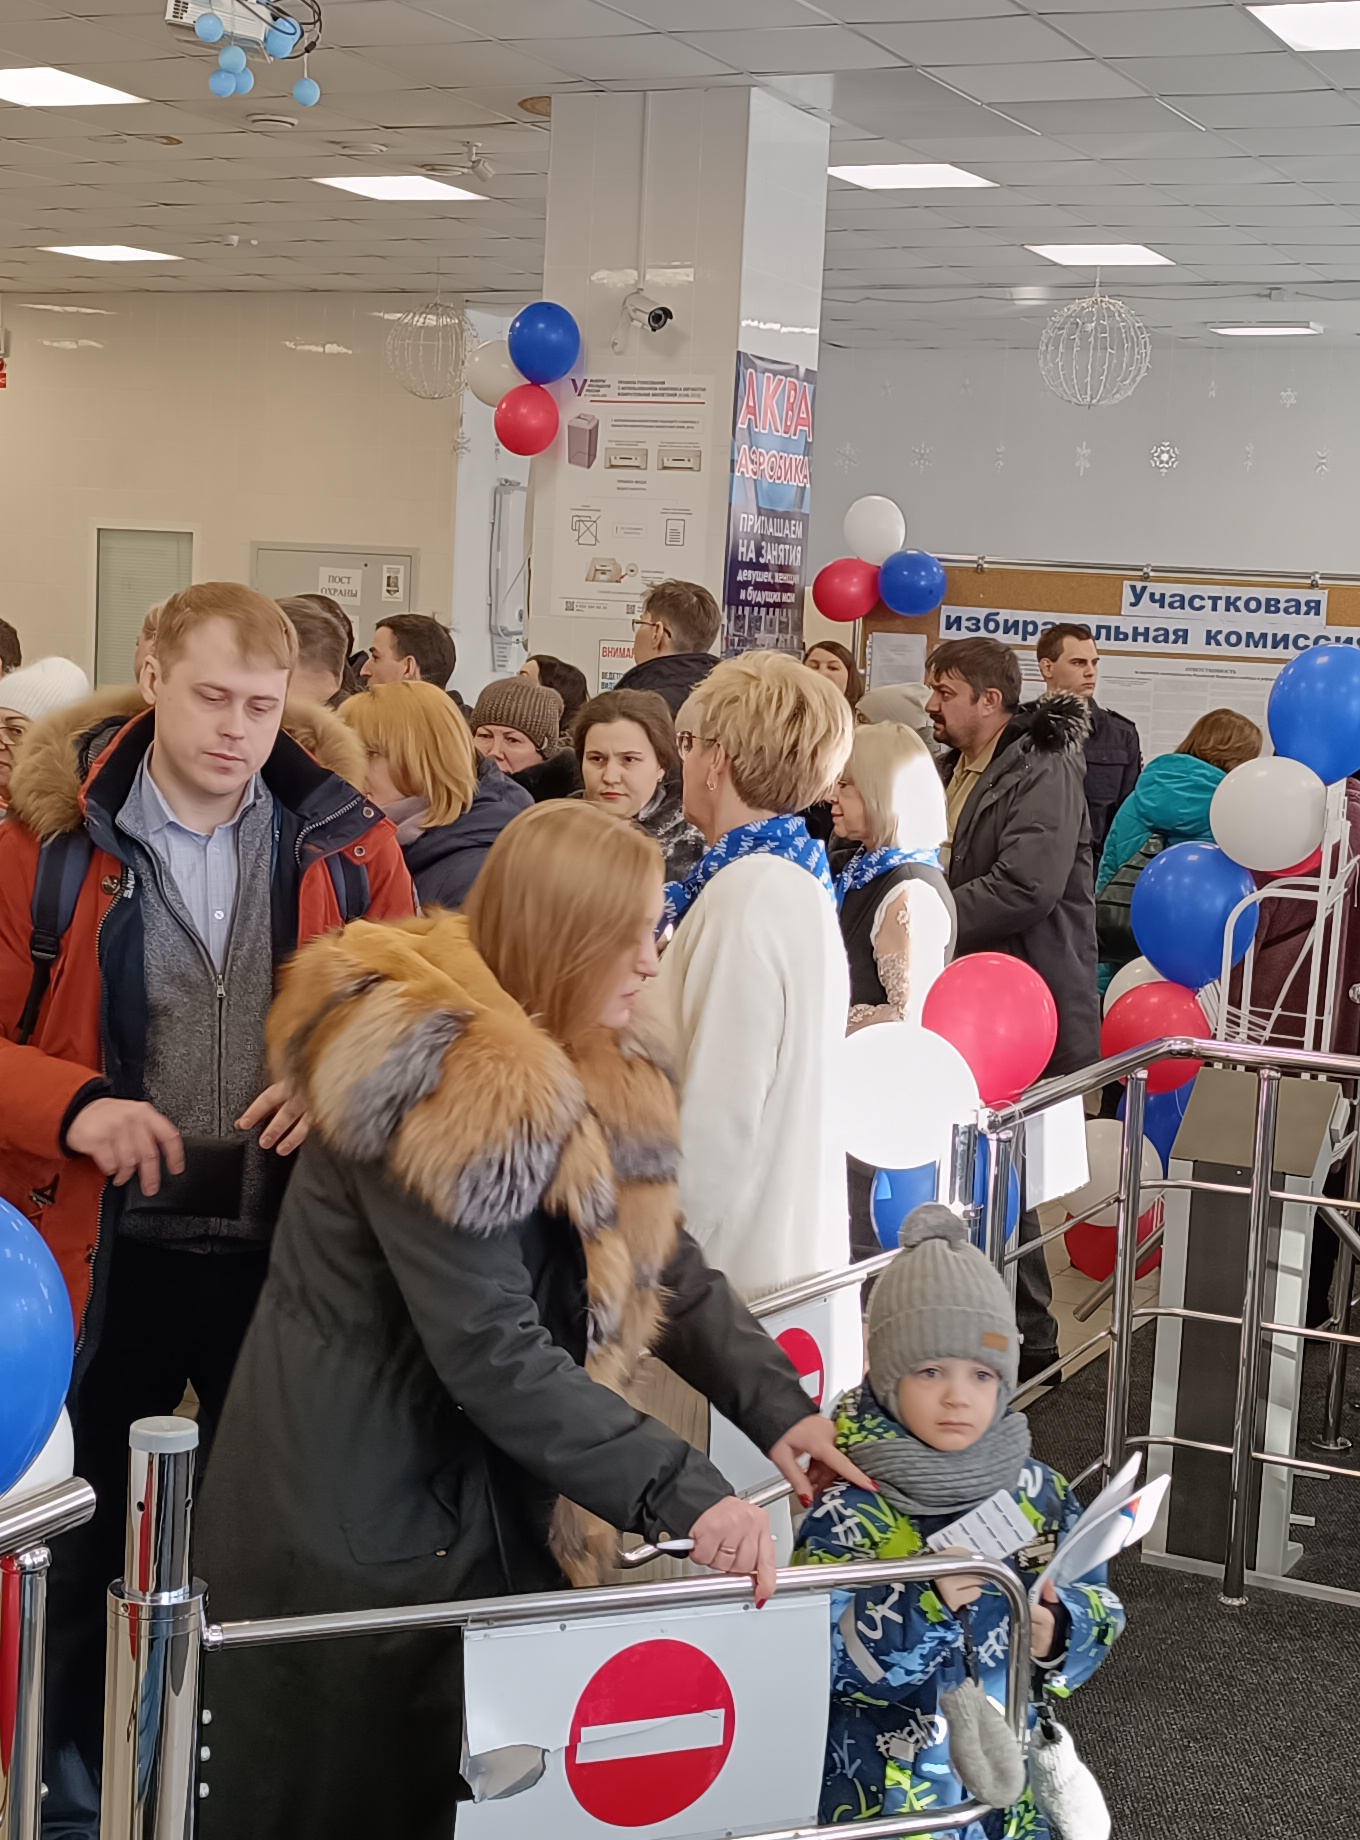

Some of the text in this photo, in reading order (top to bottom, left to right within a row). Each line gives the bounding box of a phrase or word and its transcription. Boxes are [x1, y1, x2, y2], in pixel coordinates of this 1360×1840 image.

[739, 368, 813, 442] АКВА
[735, 445, 811, 487] АЭРОБИКА
[740, 513, 802, 539] ПРИГЛАШАЕМ
[738, 539, 801, 566] НА ЗАНЯТИЯ
[321, 588, 358, 598] ОХРАНЫ
[328, 575, 352, 585] ПОСТ
[747, 586, 781, 605] будущих
[1129, 584, 1322, 616] Участковая
